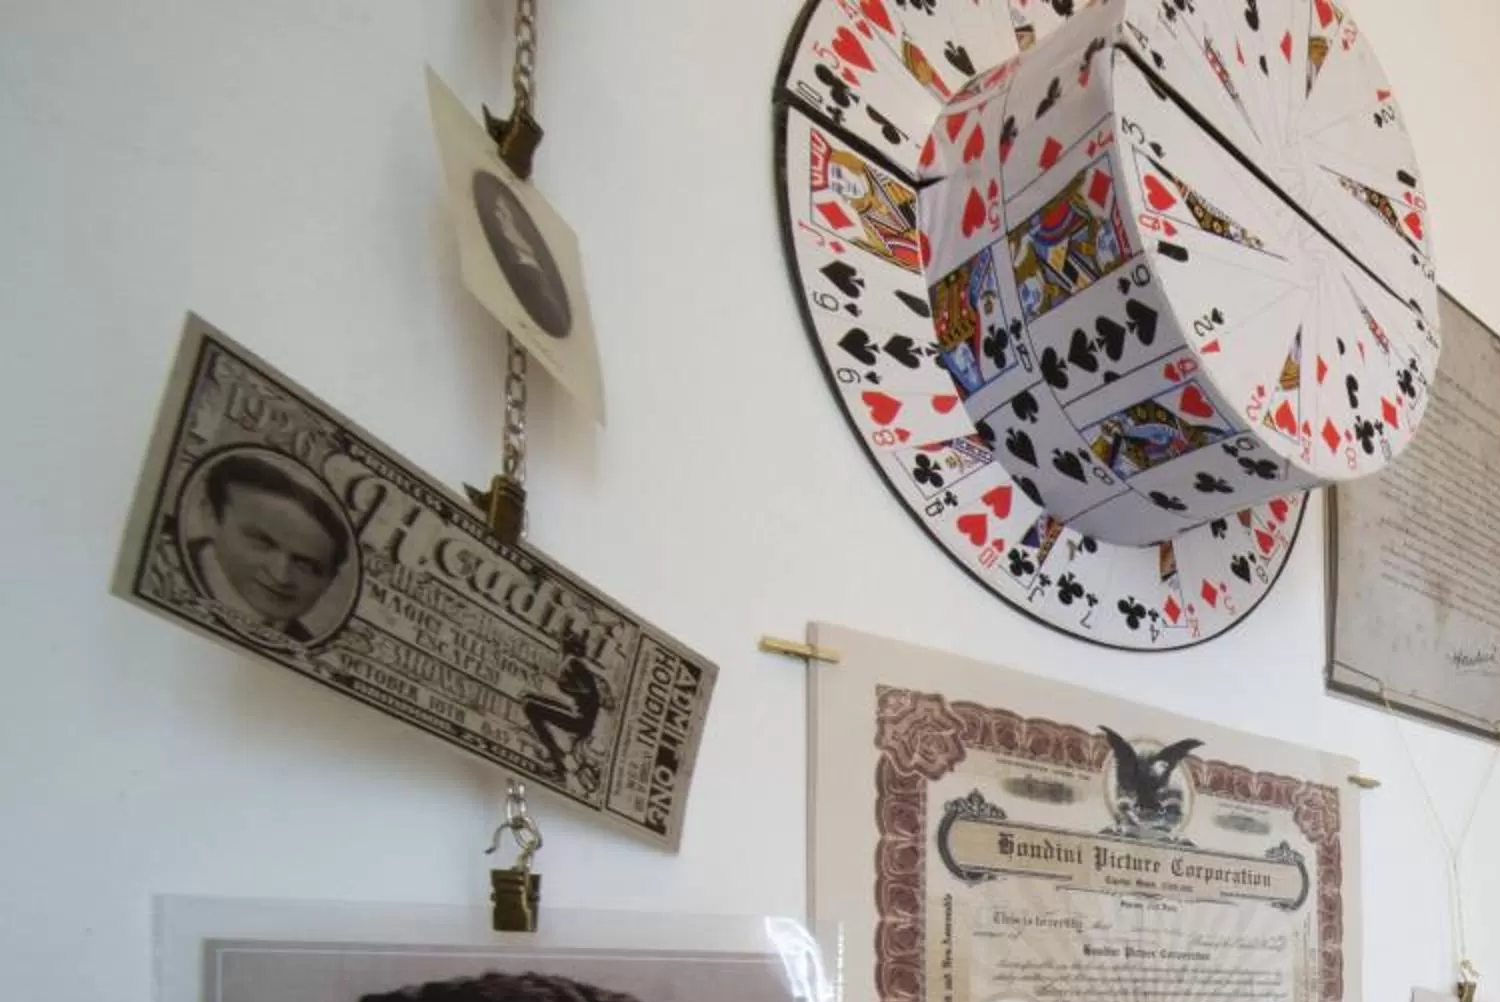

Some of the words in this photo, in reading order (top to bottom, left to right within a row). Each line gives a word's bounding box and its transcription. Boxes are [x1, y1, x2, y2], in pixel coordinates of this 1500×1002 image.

[1121, 117, 1146, 145] 3
[635, 645, 677, 750] HOUDINI
[658, 657, 700, 755] ADMIT
[641, 760, 678, 830] ONE
[997, 831, 1083, 866] Houdini
[1094, 846, 1161, 873] Picture
[1171, 856, 1272, 889] Corporation
